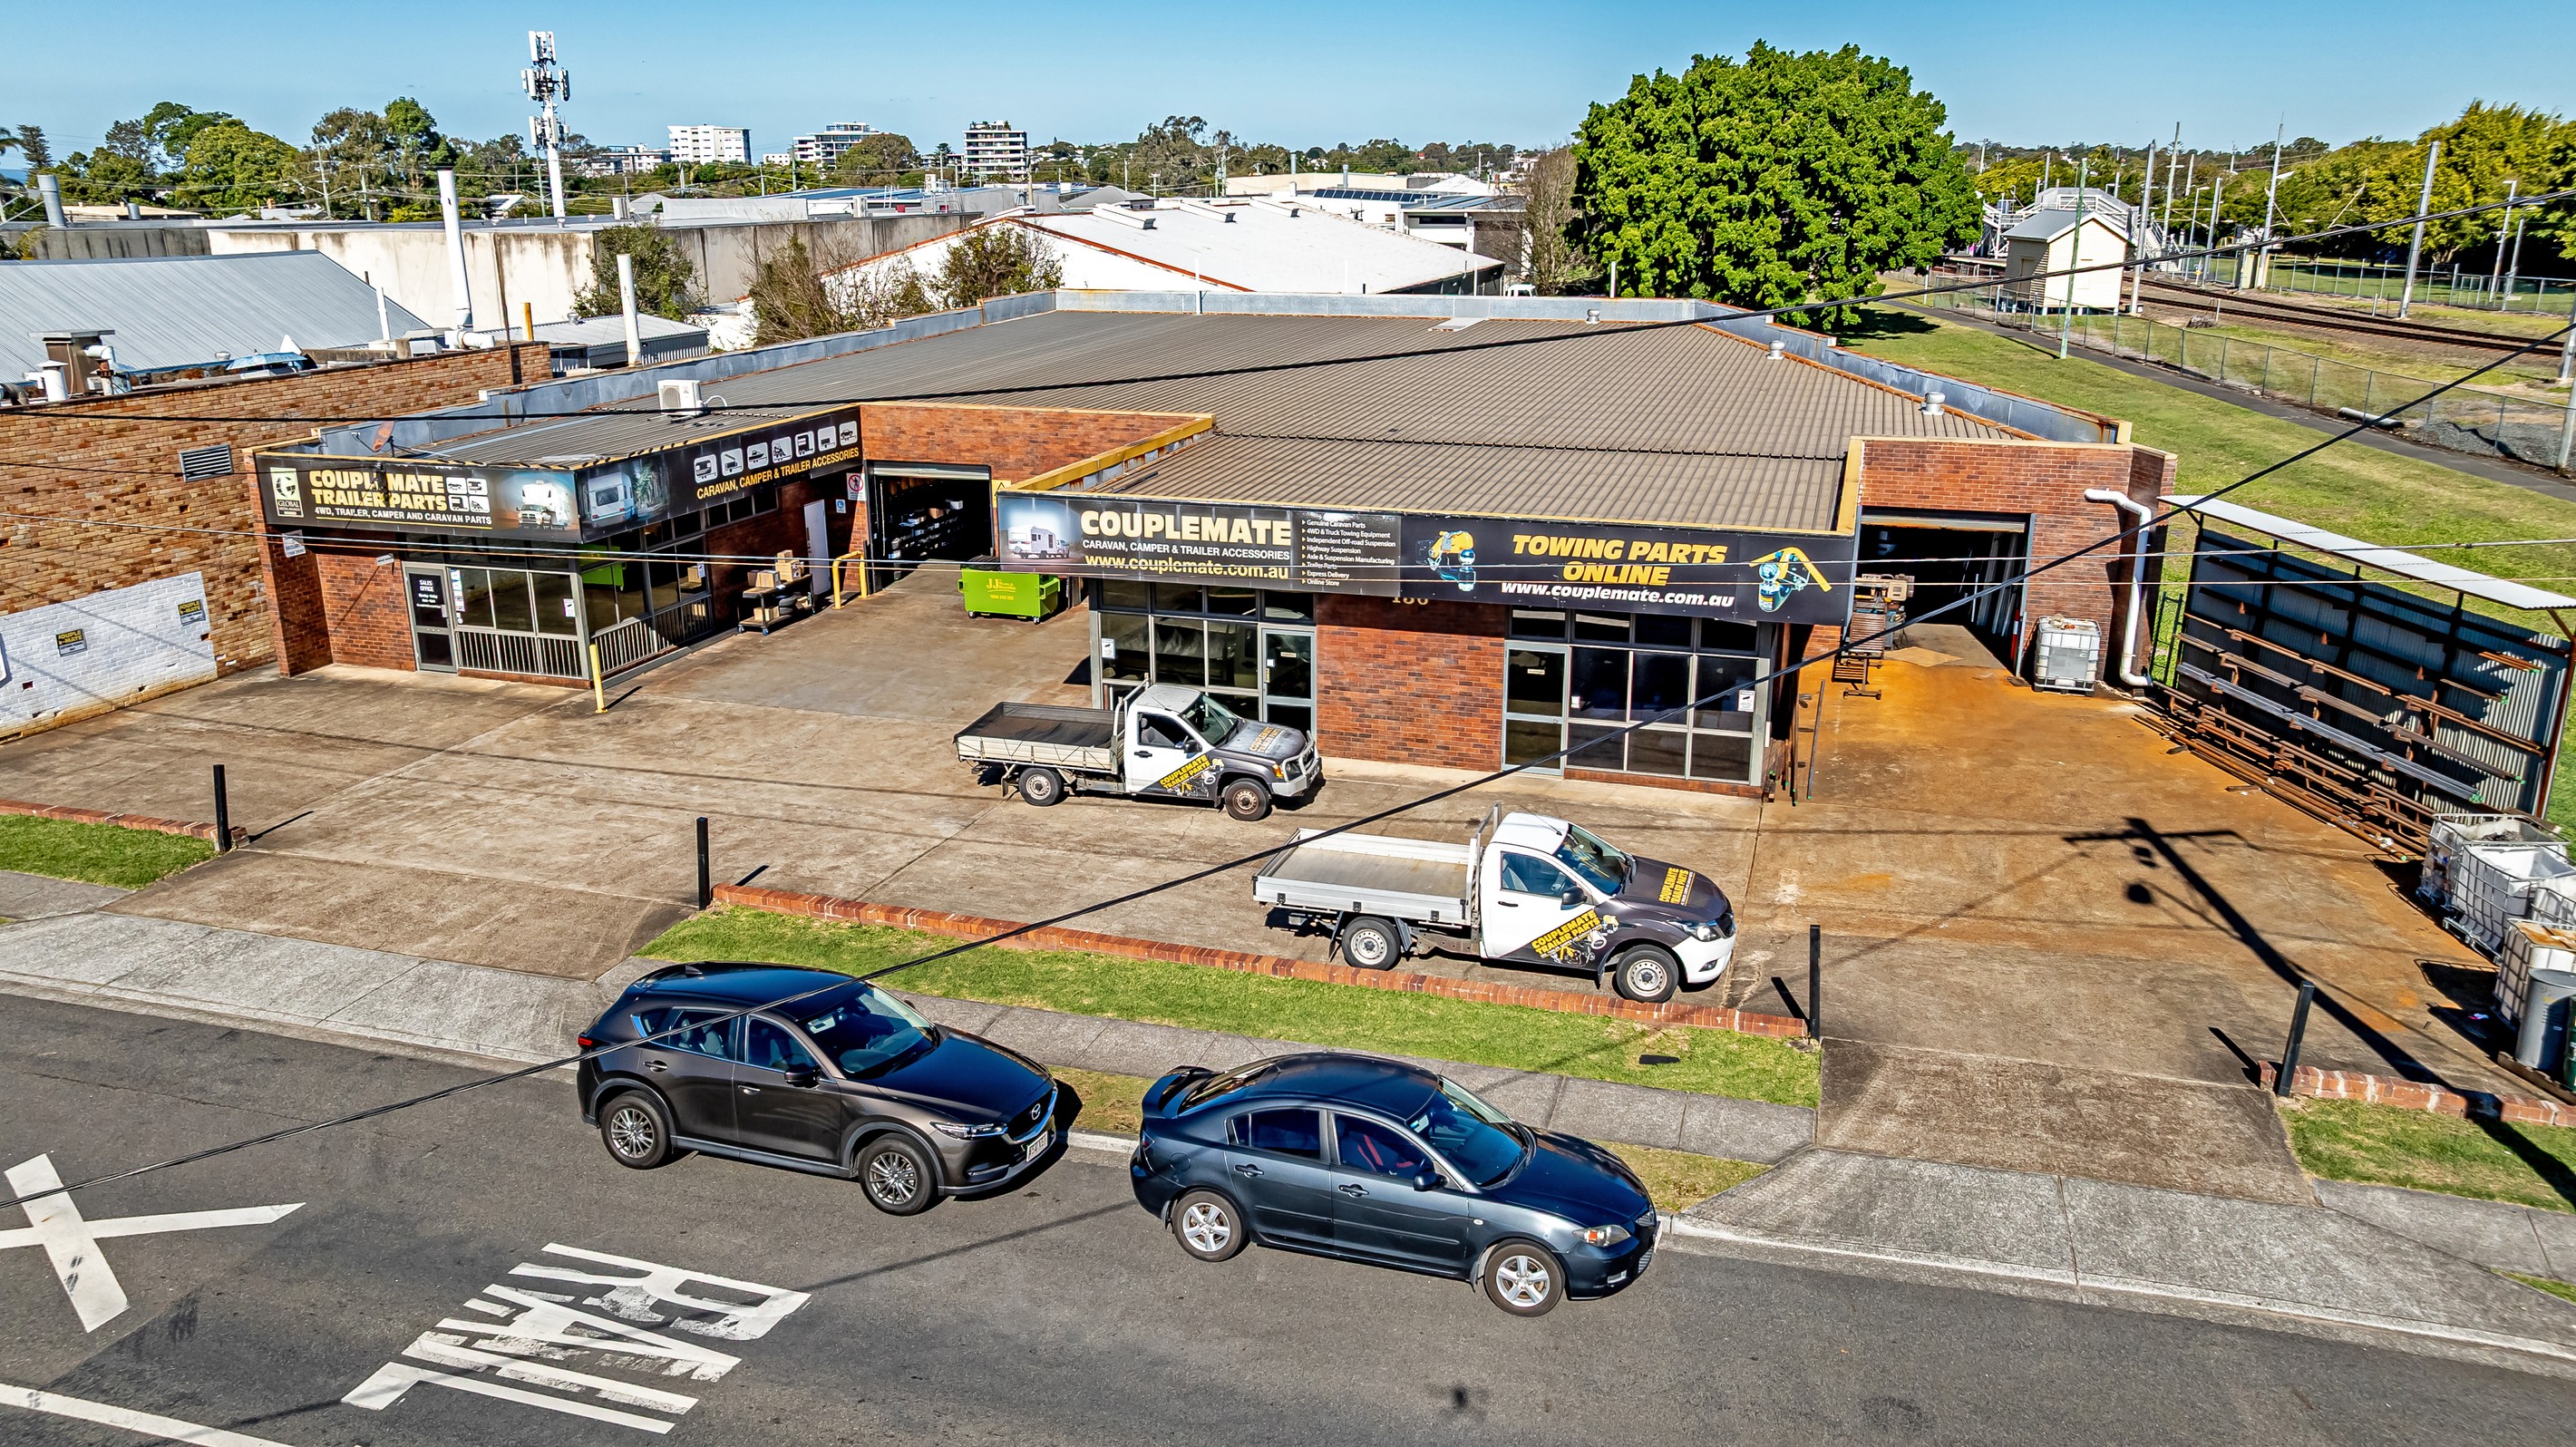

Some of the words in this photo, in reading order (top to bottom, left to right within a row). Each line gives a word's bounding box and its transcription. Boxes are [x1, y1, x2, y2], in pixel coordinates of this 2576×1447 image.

[696, 480, 738, 500] CARAVAN,
[740, 471, 772, 488] CAMPER
[773, 469, 779, 479] &
[782, 460, 811, 477] TRAILER
[812, 447, 859, 469] ACCESSORIES
[311, 489, 385, 508] TRAILER
[389, 493, 447, 511] PARTS
[315, 507, 335, 516] 4WD,
[372, 510, 404, 520] CAMPER
[407, 512, 423, 520] AND
[424, 513, 462, 523] CARAVAN
[465, 516, 491, 525] PARTS
[1081, 510, 1291, 546] COUPLEMATE
[1083, 540, 1128, 552] CARAVAN,
[1130, 542, 1170, 553] CAMPER
[1171, 545, 1179, 554] &
[1181, 545, 1220, 557] TRAILER
[1221, 548, 1290, 560] ACCESSORIES
[1307, 537, 1340, 545] Independent
[1307, 545, 1329, 553] Highway
[1512, 535, 1625, 560] TOWING
[1628, 541, 1727, 564] PARTS
[1084, 555, 1289, 579] www.couplemate.com.au
[1355, 556, 1395, 565] Manufacturing
[1562, 560, 1671, 586] ONLINE
[1327, 571, 1349, 579] Delivery
[1501, 582, 1735, 607] www.couplemate.com.au
[1160, 754, 1208, 785] COUPLEMATE
[1163, 773, 1190, 789] TRAILER
[1189, 761, 1210, 775] PARTS
[1658, 867, 1679, 902] COUPLEMATE
[1531, 909, 1597, 948] COUPLEMATE
[1535, 932, 1572, 954] TRAILER
[1571, 918, 1600, 937] PARTS
